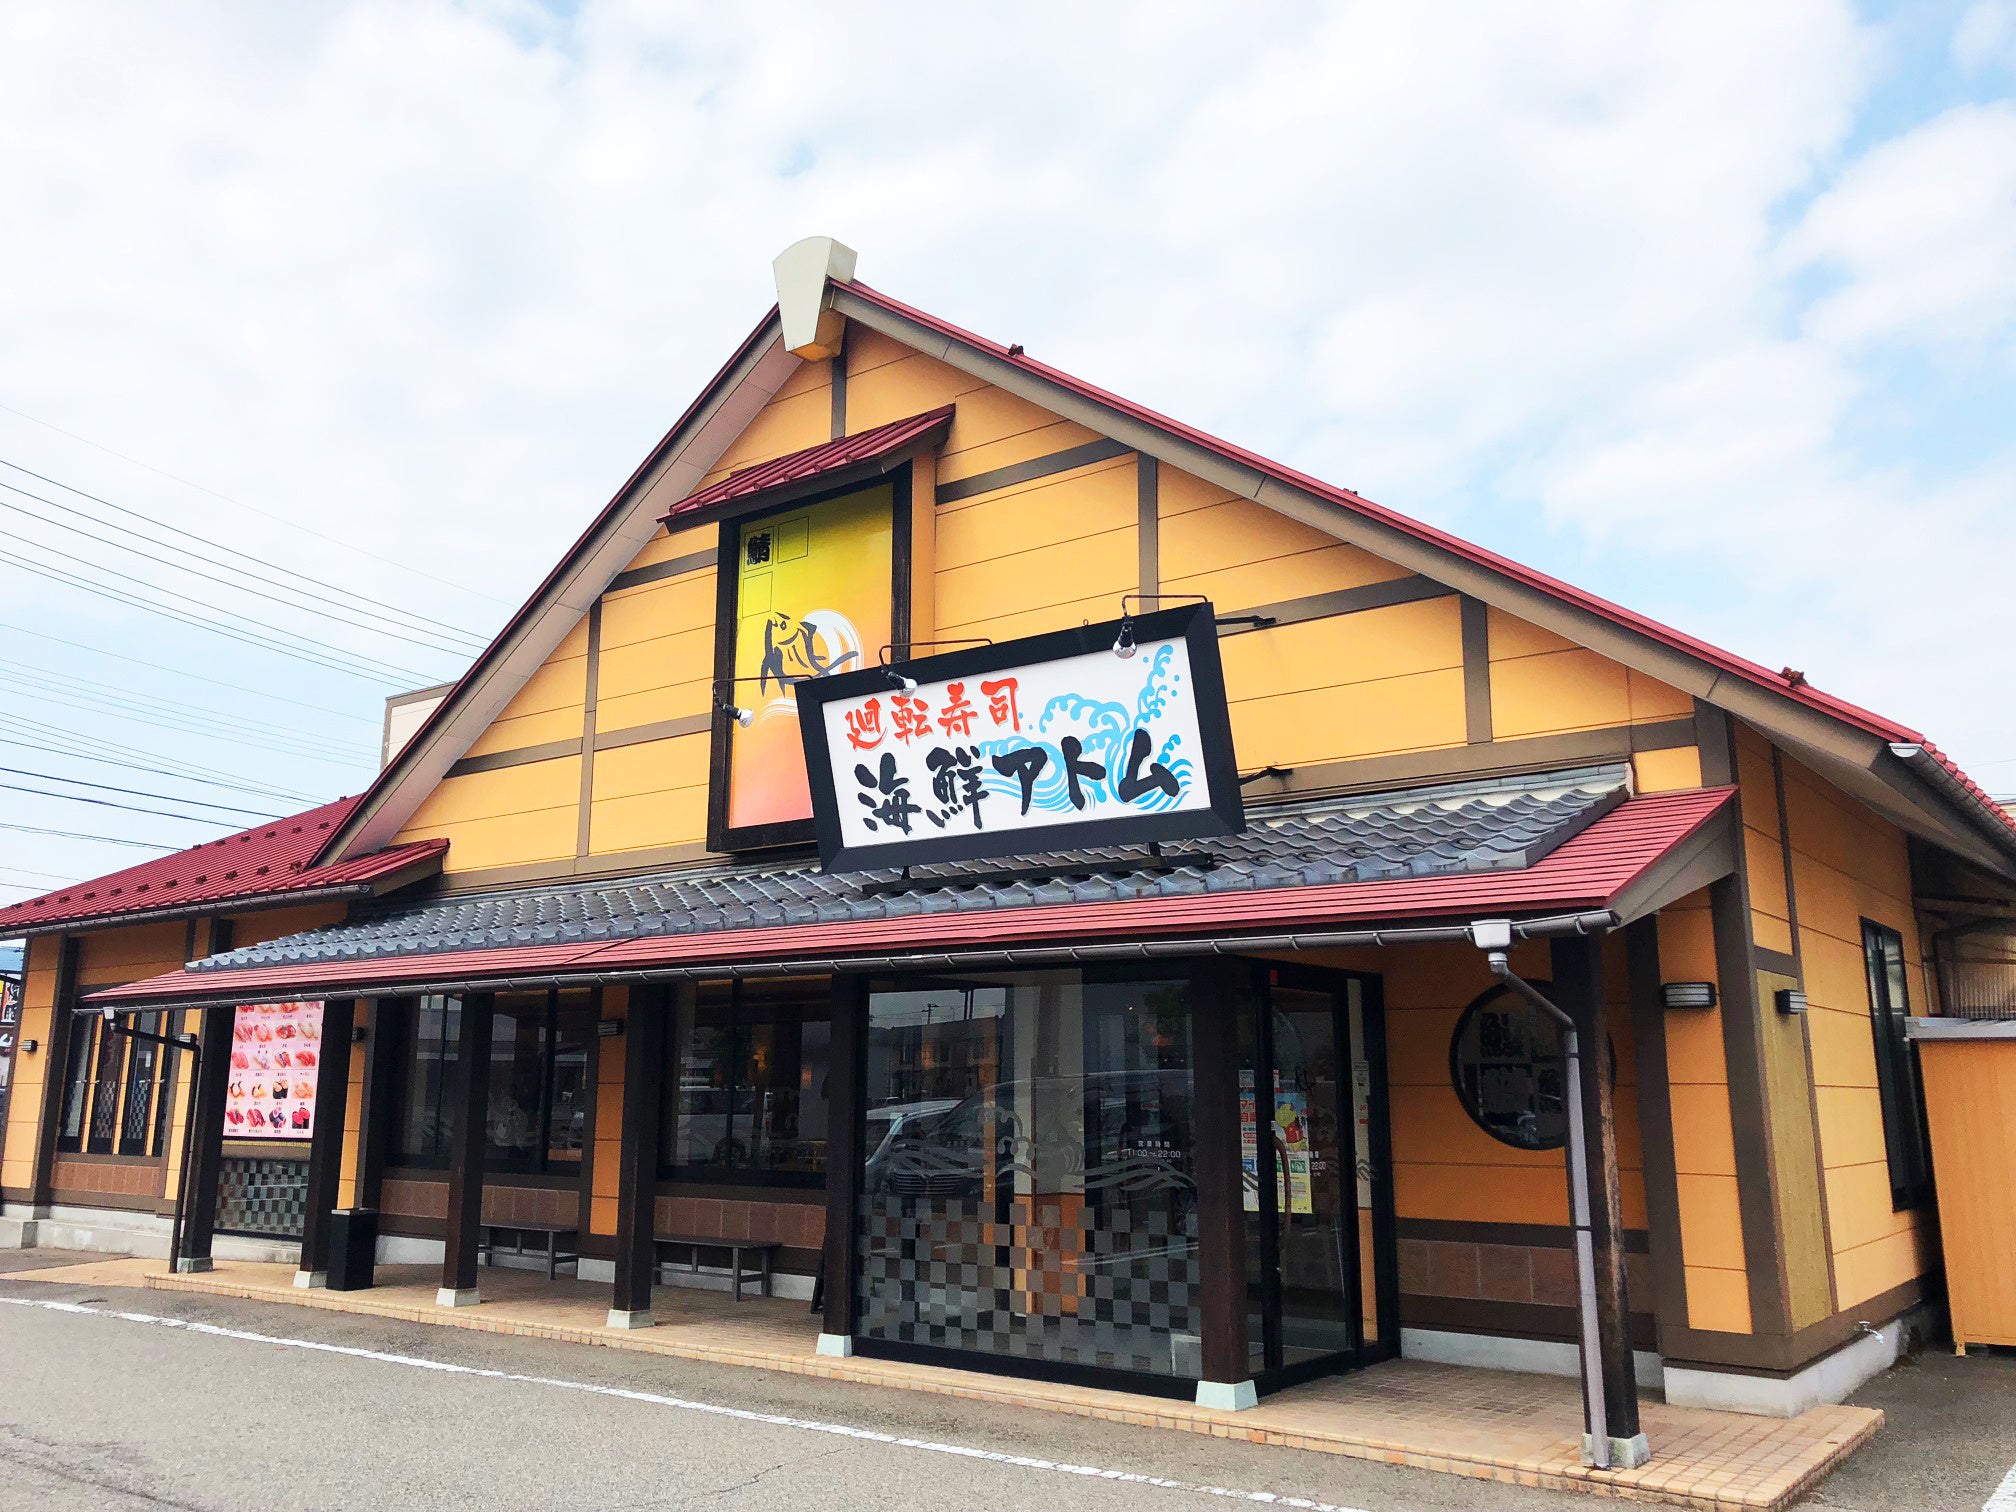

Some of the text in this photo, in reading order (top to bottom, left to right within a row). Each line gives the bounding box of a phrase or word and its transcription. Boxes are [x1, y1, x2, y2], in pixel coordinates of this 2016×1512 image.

[846, 677, 1024, 751] 廻転寿司
[854, 728, 1183, 836] 海鮮アトム
